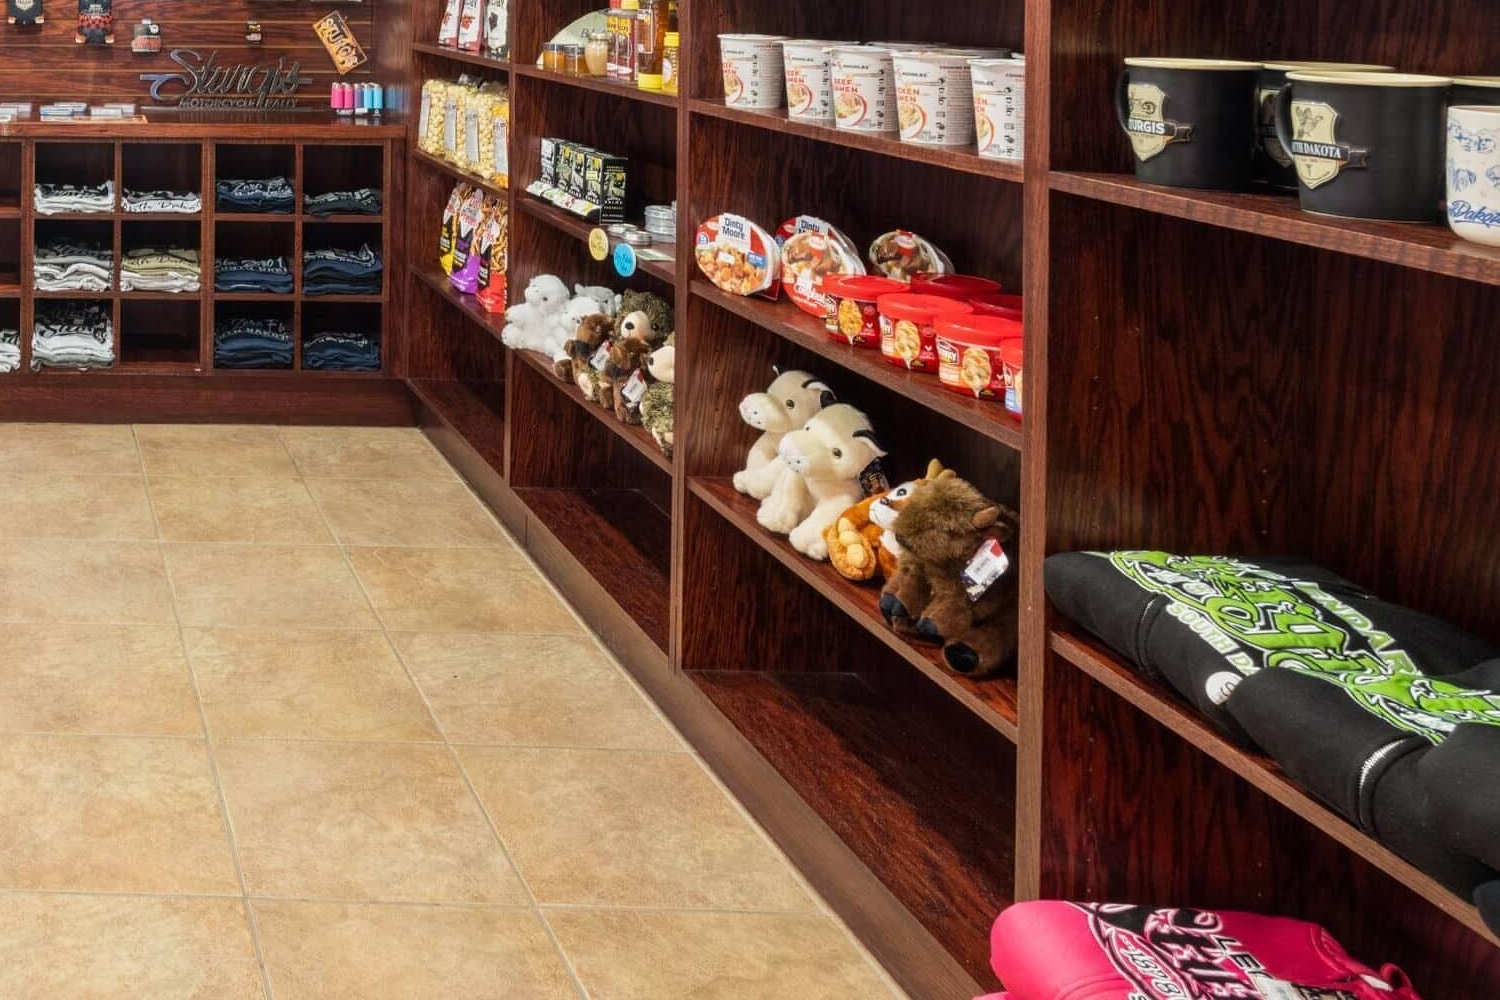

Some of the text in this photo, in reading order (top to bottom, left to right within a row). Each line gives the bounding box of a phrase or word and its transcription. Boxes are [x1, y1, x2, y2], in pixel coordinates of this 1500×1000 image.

[140, 49, 313, 107] Sturgis
[1303, 143, 1341, 160] DAKOTA
[722, 227, 746, 240] Moore
[724, 217, 744, 233] Dinty
[1166, 601, 1241, 654] SOUTH
